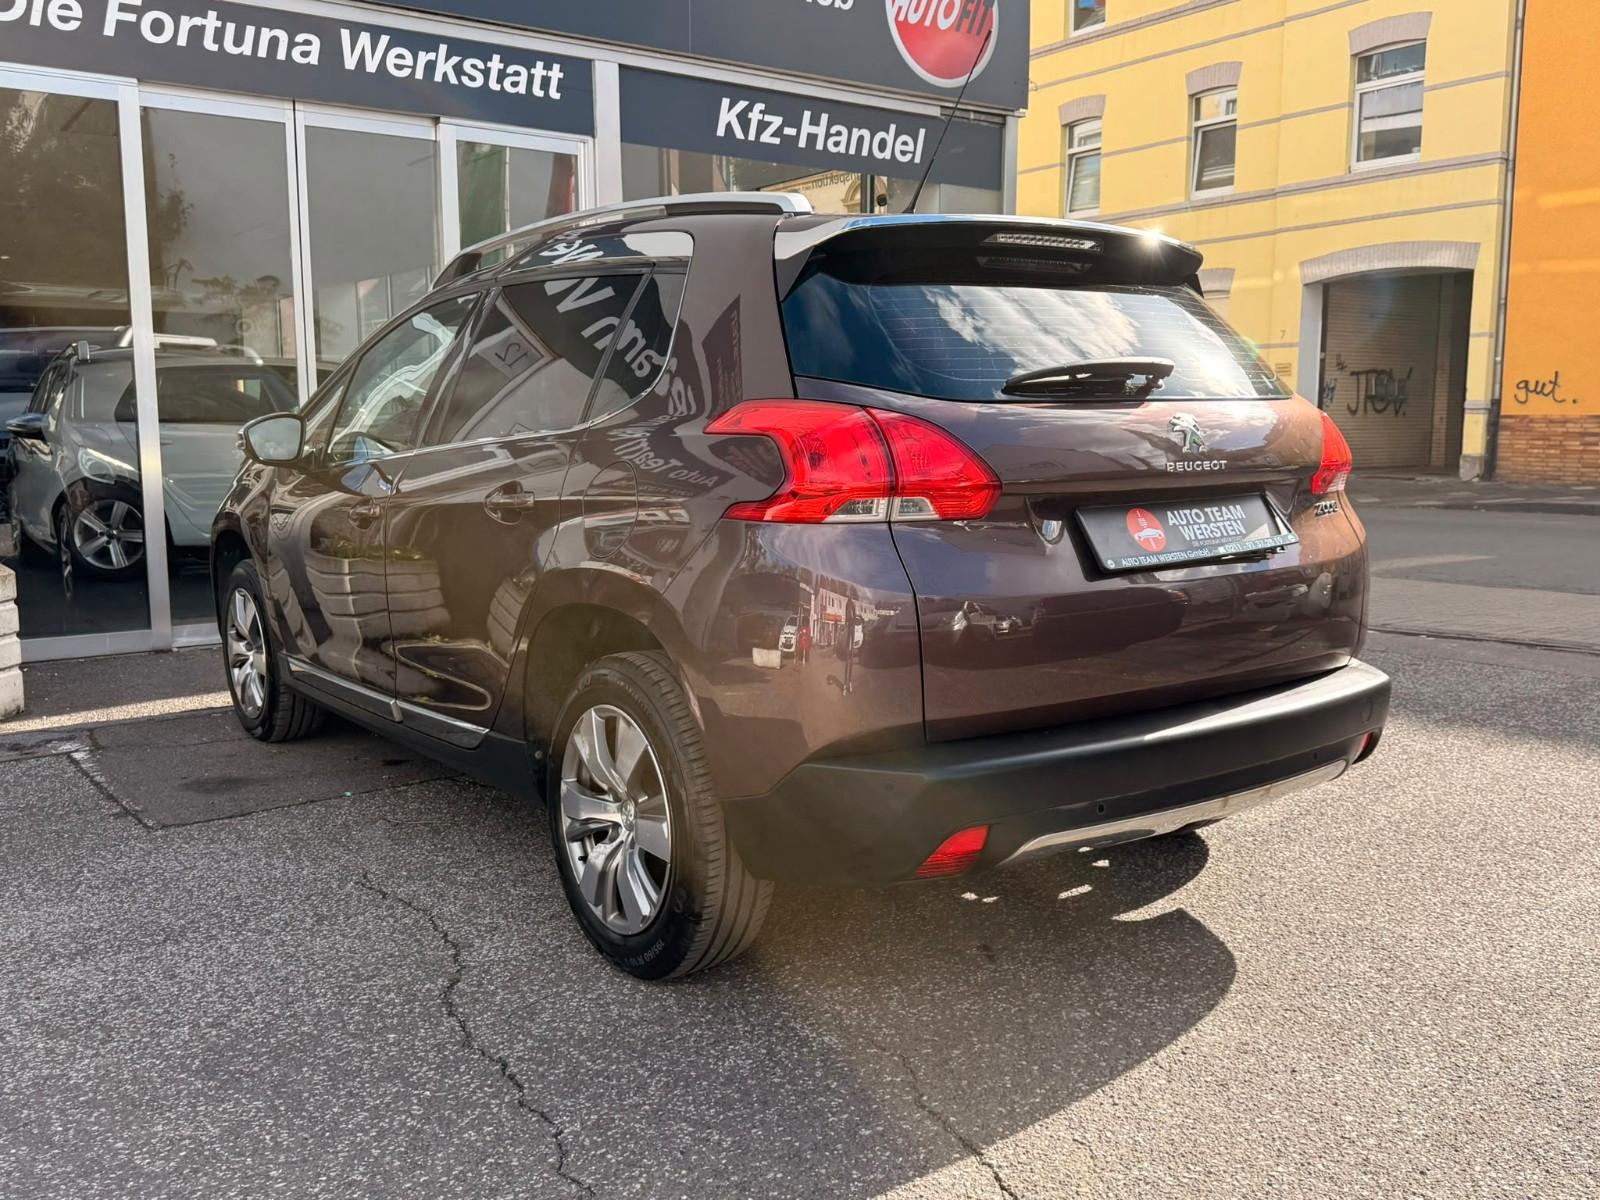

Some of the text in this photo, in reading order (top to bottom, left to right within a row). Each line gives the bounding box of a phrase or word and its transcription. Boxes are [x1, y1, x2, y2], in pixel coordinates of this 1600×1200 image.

[102, 0, 322, 66] Fortuna
[339, 28, 565, 101] Werkstatt
[716, 97, 926, 164] Kfz-Handel
[1166, 459, 1228, 473] PEUGEOT
[1166, 504, 1247, 527] AUTO TEAM
[1177, 520, 1247, 541] WERSTEN
[1120, 557, 1139, 567] AUTO
[1138, 554, 1159, 565] TEAM
[1158, 551, 1187, 563] WERSTEN
